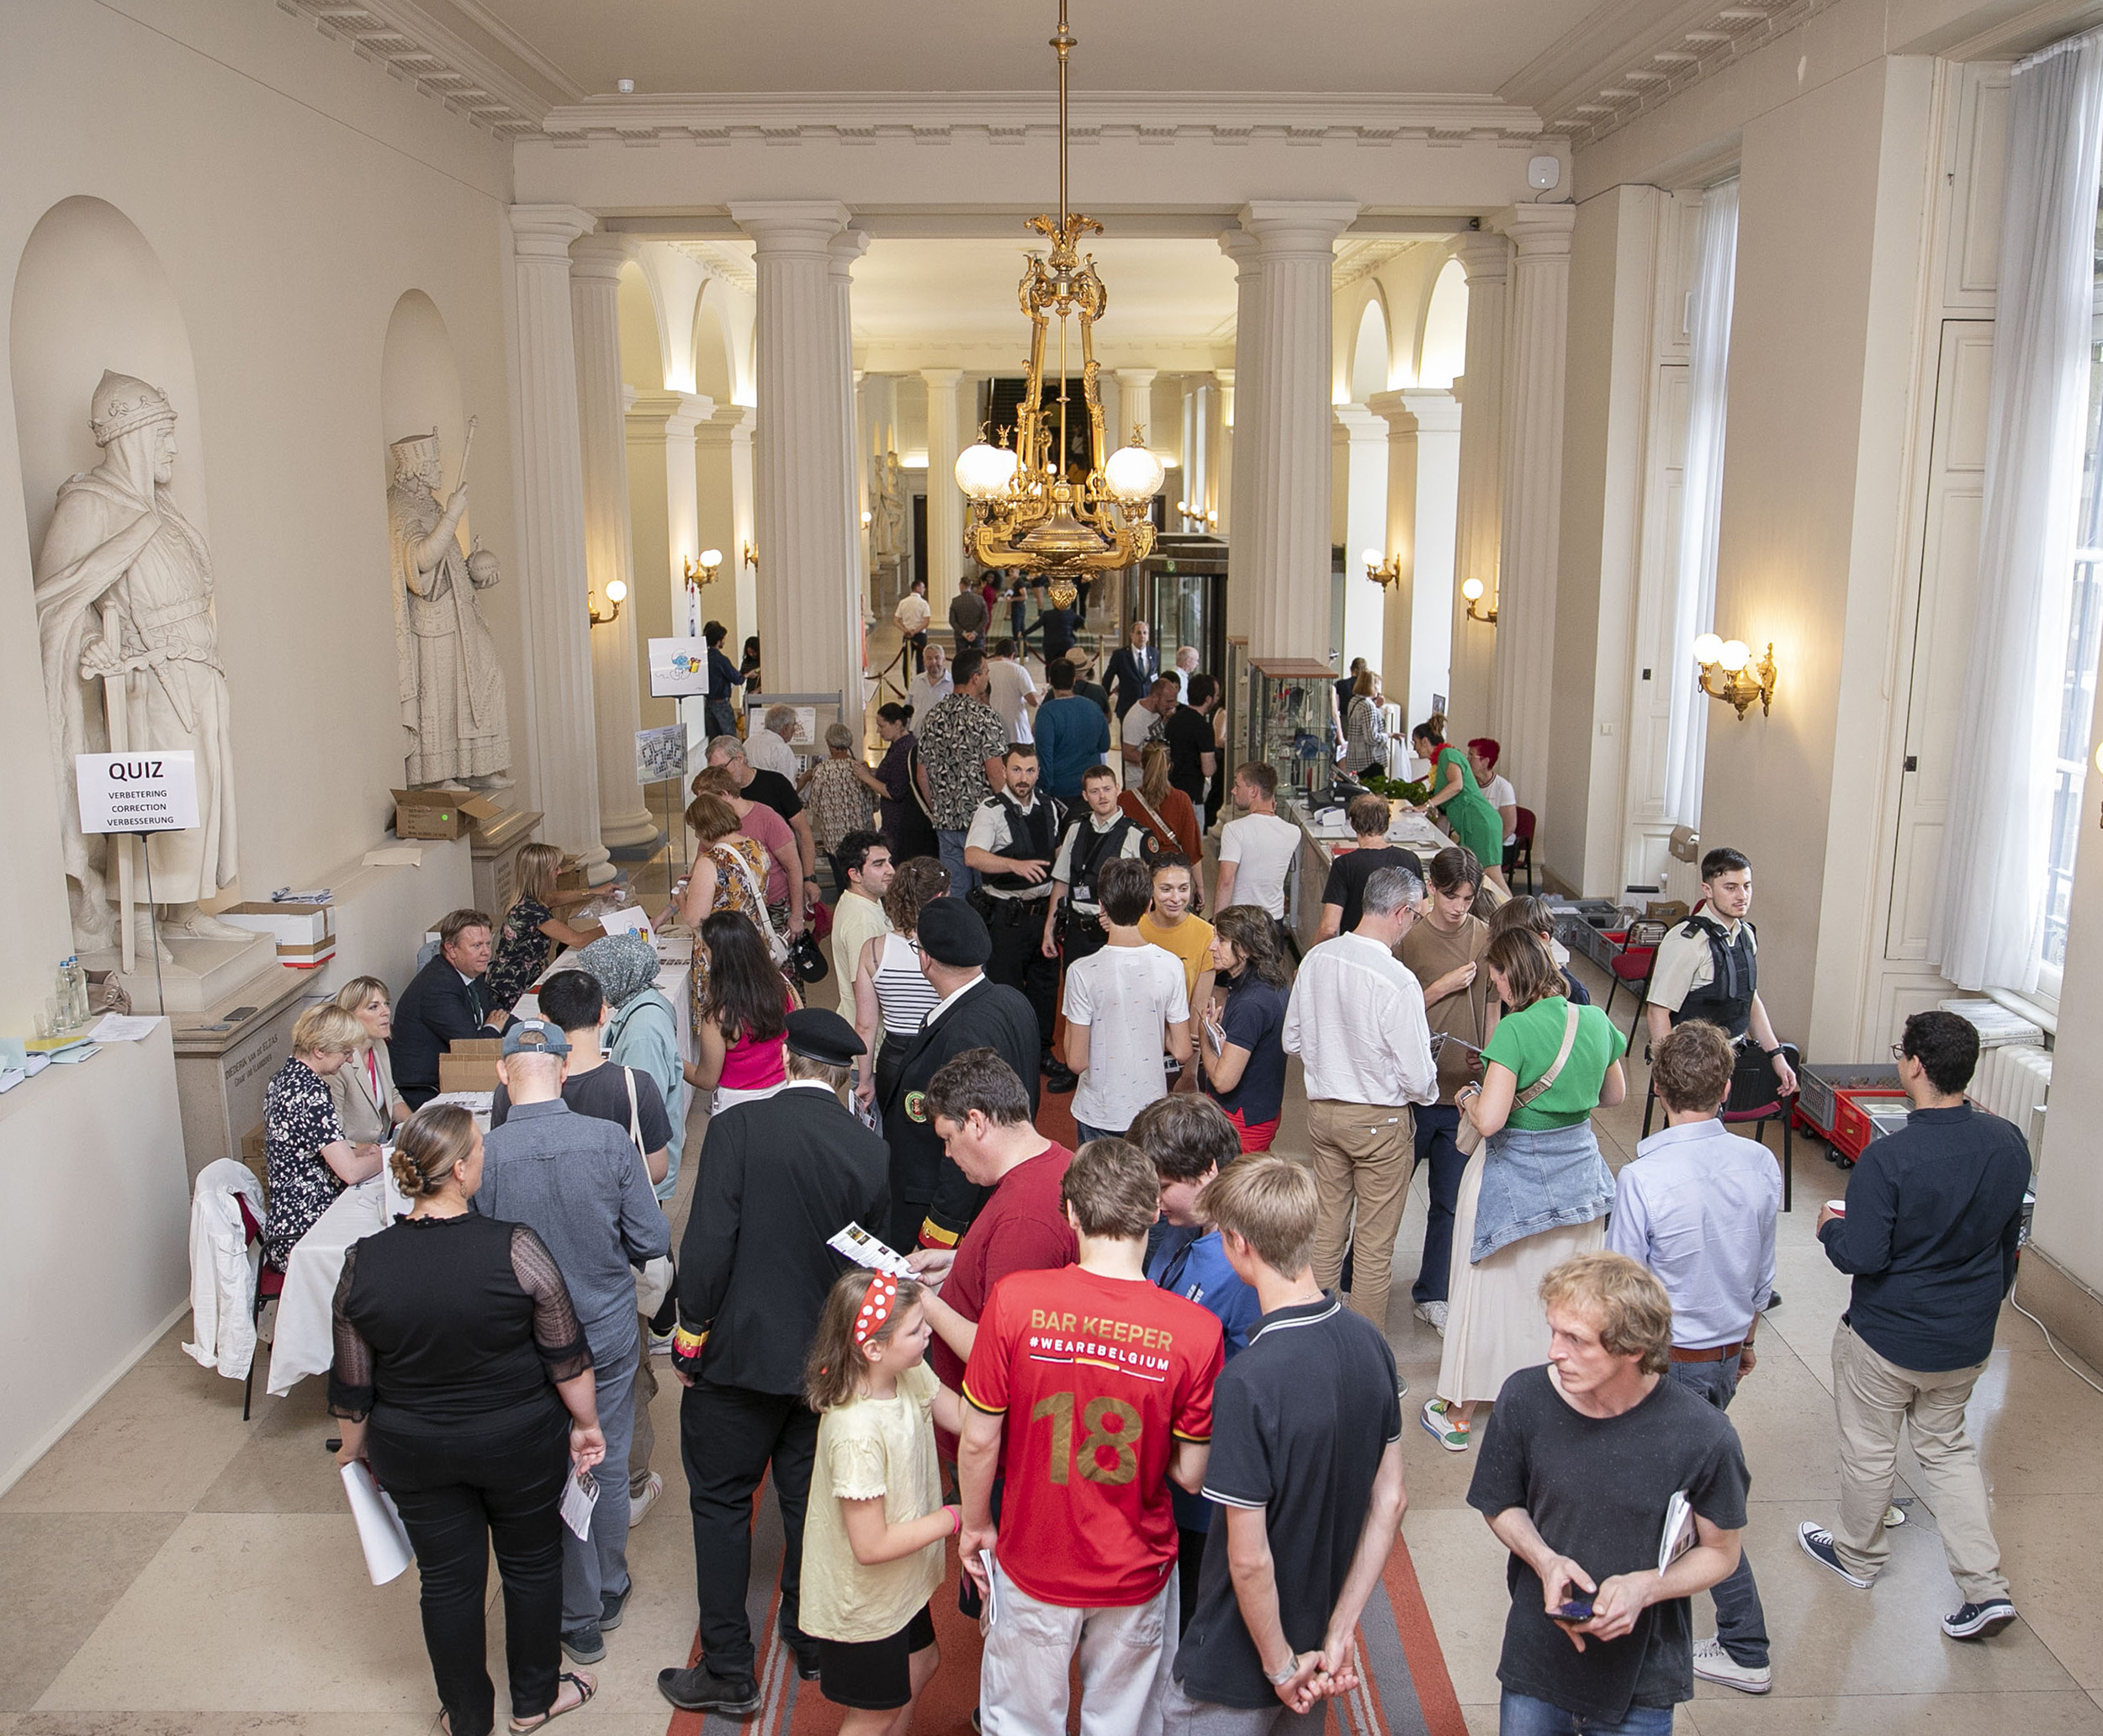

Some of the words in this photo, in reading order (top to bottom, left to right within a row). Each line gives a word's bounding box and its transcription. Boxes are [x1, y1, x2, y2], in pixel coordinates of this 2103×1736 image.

[109, 761, 164, 782] QUIZ
[109, 790, 167, 800] VERBETERING
[111, 803, 167, 813] CORRECTION
[107, 816, 174, 827] VERBESSERUNG
[225, 1059, 247, 1080] DIEDERIK
[262, 1034, 278, 1051] ELZAS
[1030, 1309, 1077, 1333] BAR
[1081, 1315, 1173, 1352] KEEPER
[1029, 1336, 1170, 1372] #WEAREBELGIUM
[1032, 1391, 1143, 1486] 18
